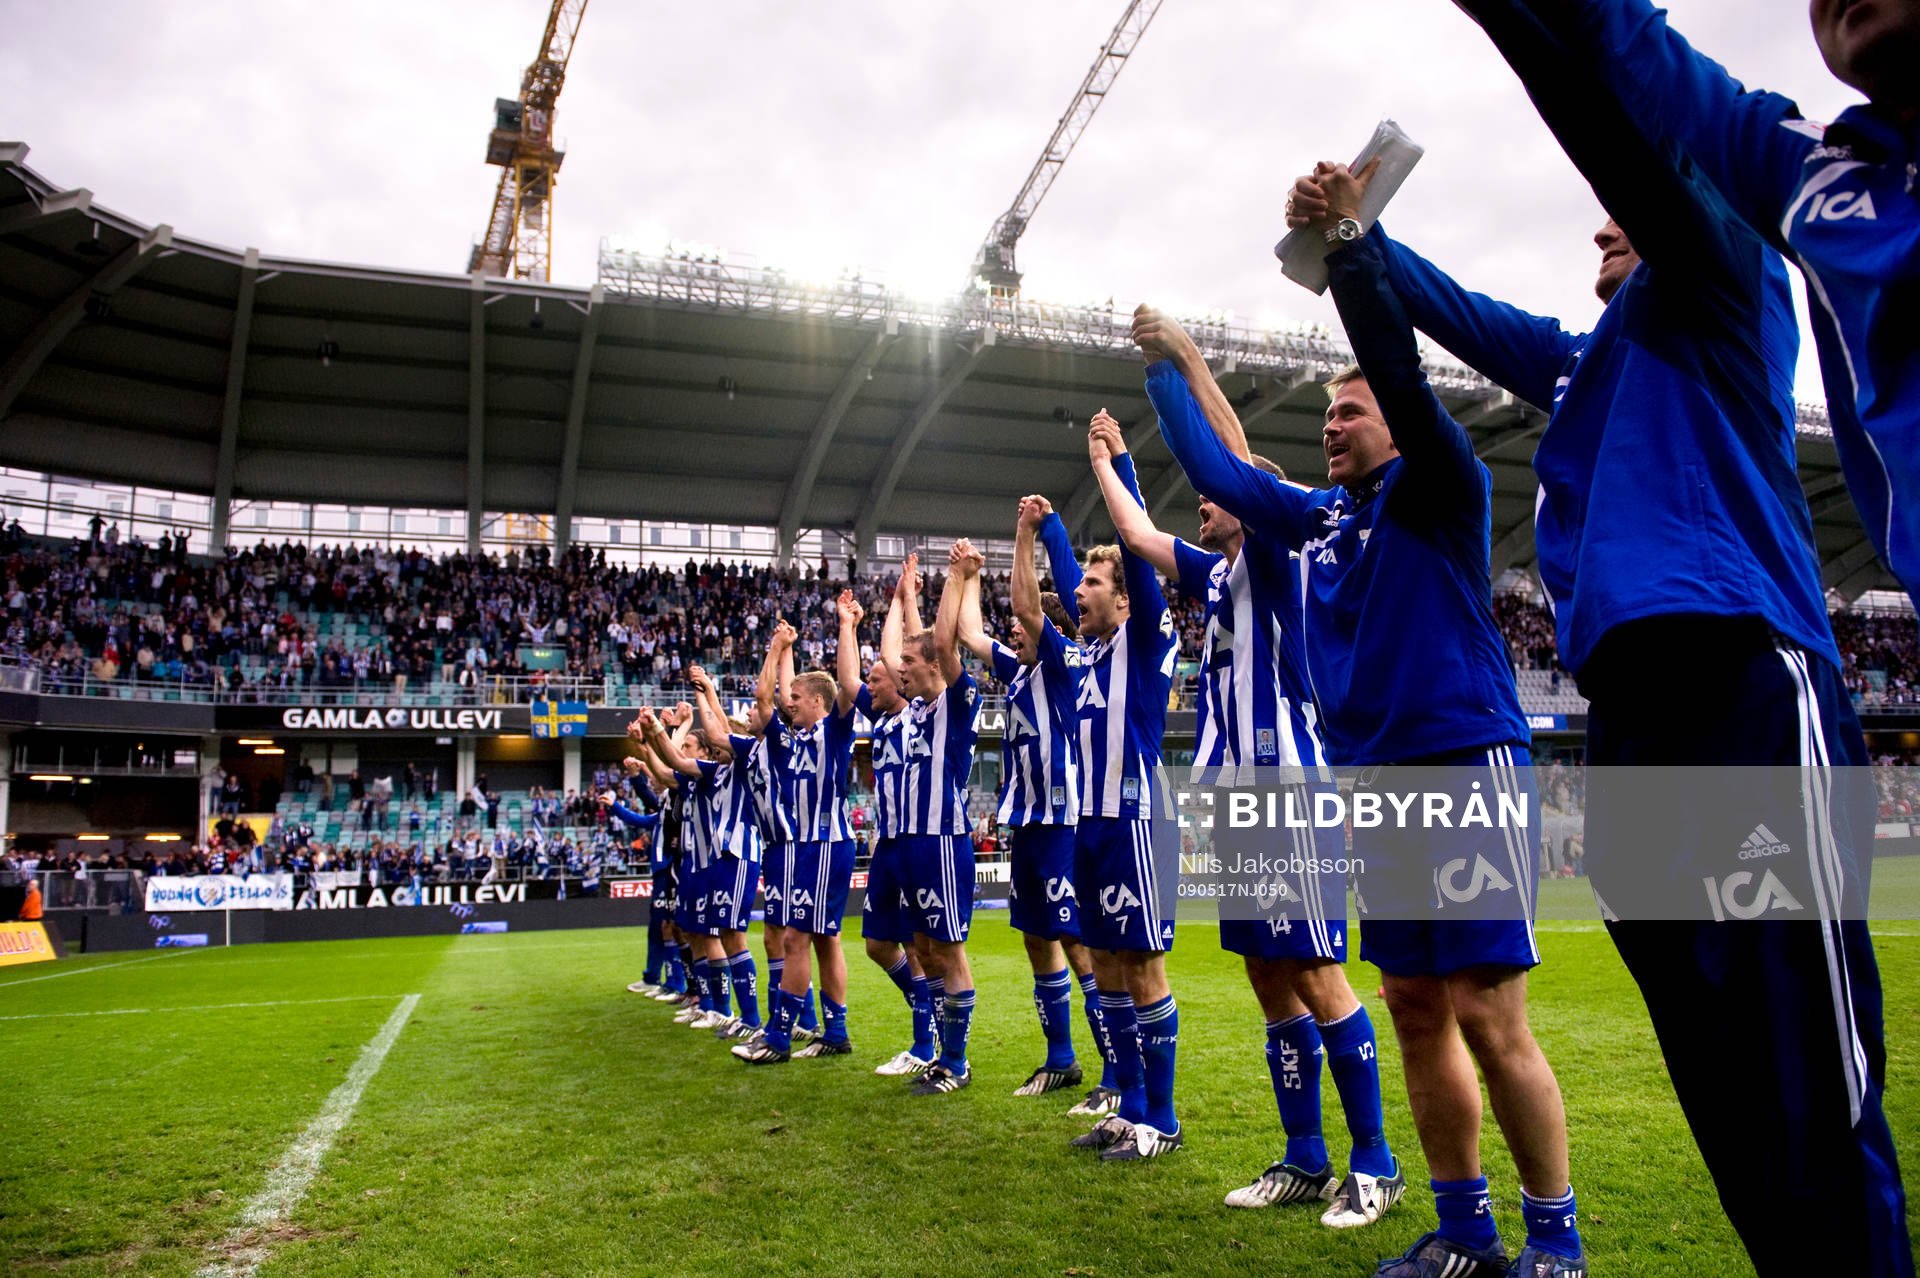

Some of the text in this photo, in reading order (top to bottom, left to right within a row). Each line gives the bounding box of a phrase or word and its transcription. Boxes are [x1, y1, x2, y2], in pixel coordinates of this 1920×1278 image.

[1804, 189, 1878, 223] ICA
[282, 708, 502, 730] GAMLA ULLEVI
[1737, 842, 1791, 861] adidas
[1433, 852, 1514, 909] ICA
[296, 883, 528, 910] AMLA ULLEVI
[1702, 867, 1805, 922] ICA
[718, 907, 726, 918] 6
[766, 903, 775, 915] 5
[793, 907, 806, 920] 19
[1058, 906, 1071, 922] 9
[925, 913, 941, 929] 17
[1115, 915, 1129, 935] 7
[1266, 911, 1293, 938] 14
[1280, 1039, 1302, 1090] SKF
